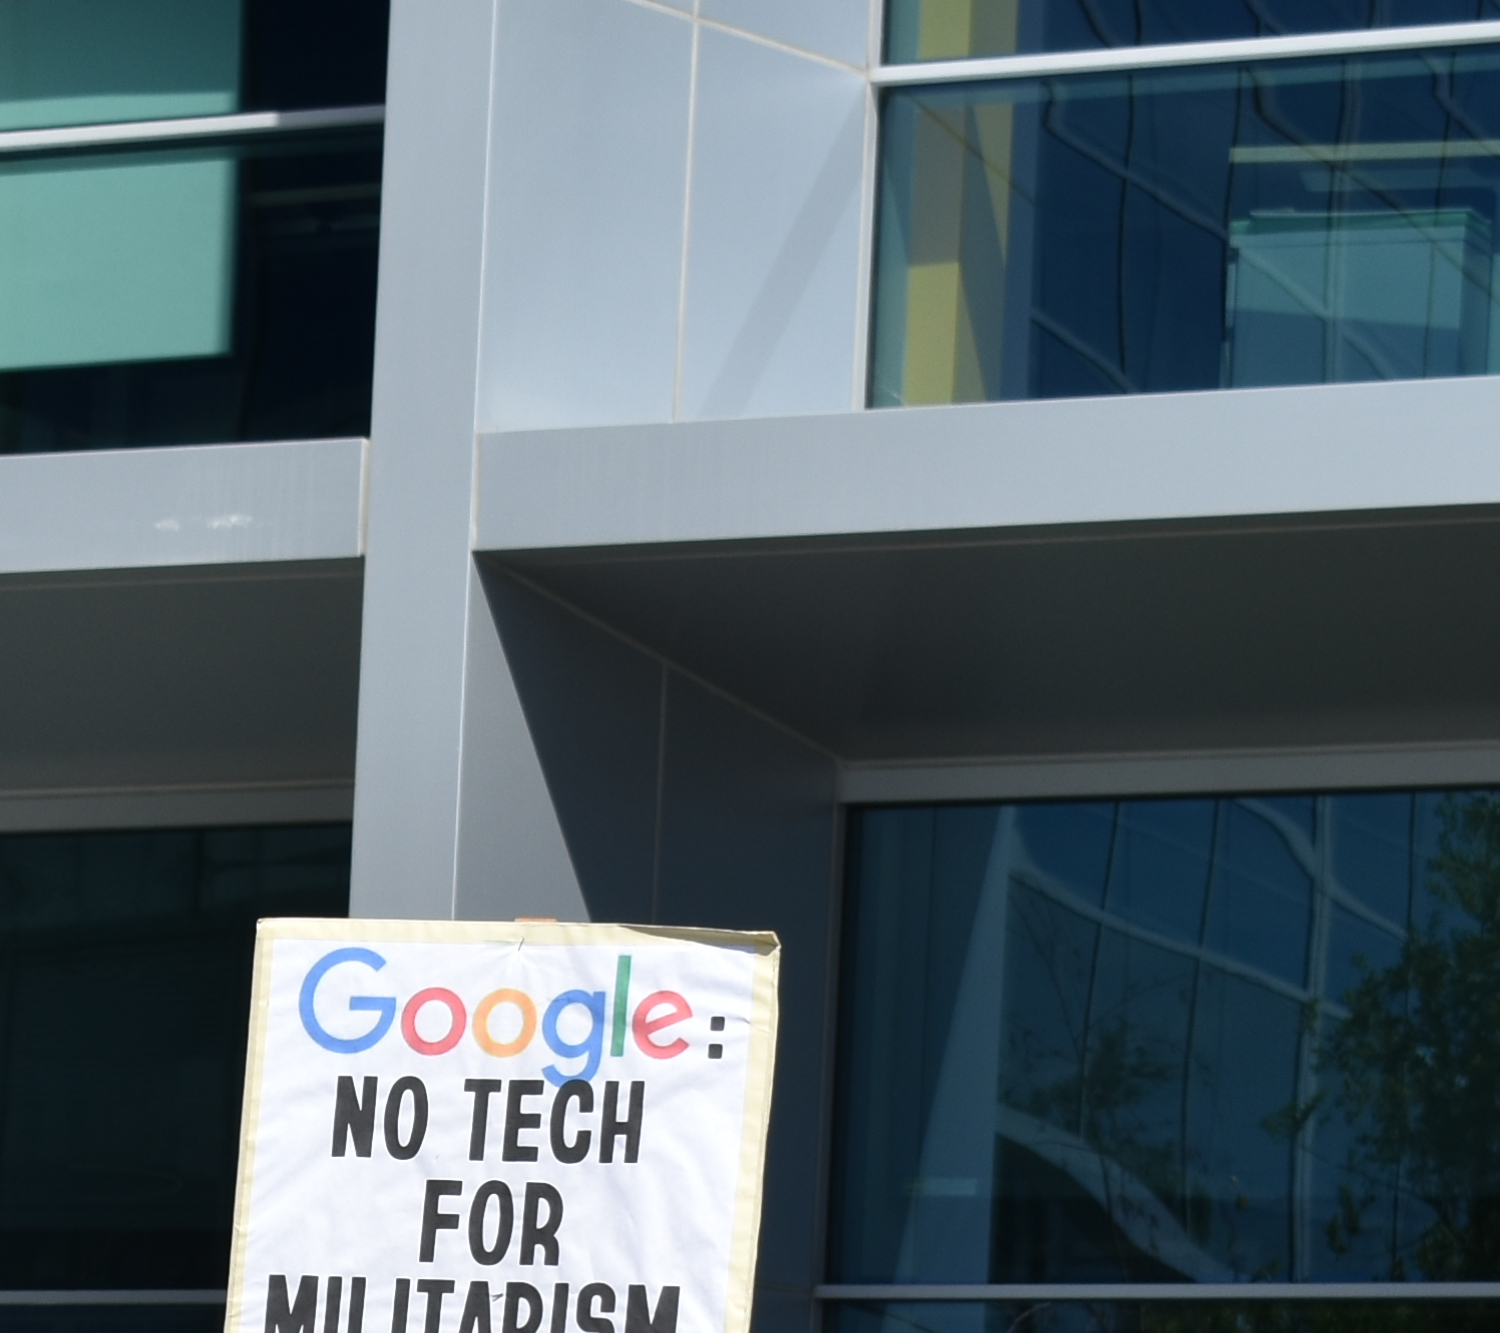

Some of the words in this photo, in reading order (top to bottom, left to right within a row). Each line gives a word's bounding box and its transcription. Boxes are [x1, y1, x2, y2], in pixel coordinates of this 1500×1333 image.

[298, 946, 726, 1087] Google:
[331, 1075, 429, 1160] NO
[464, 1078, 646, 1164] TECH
[418, 1179, 564, 1267] FOR
